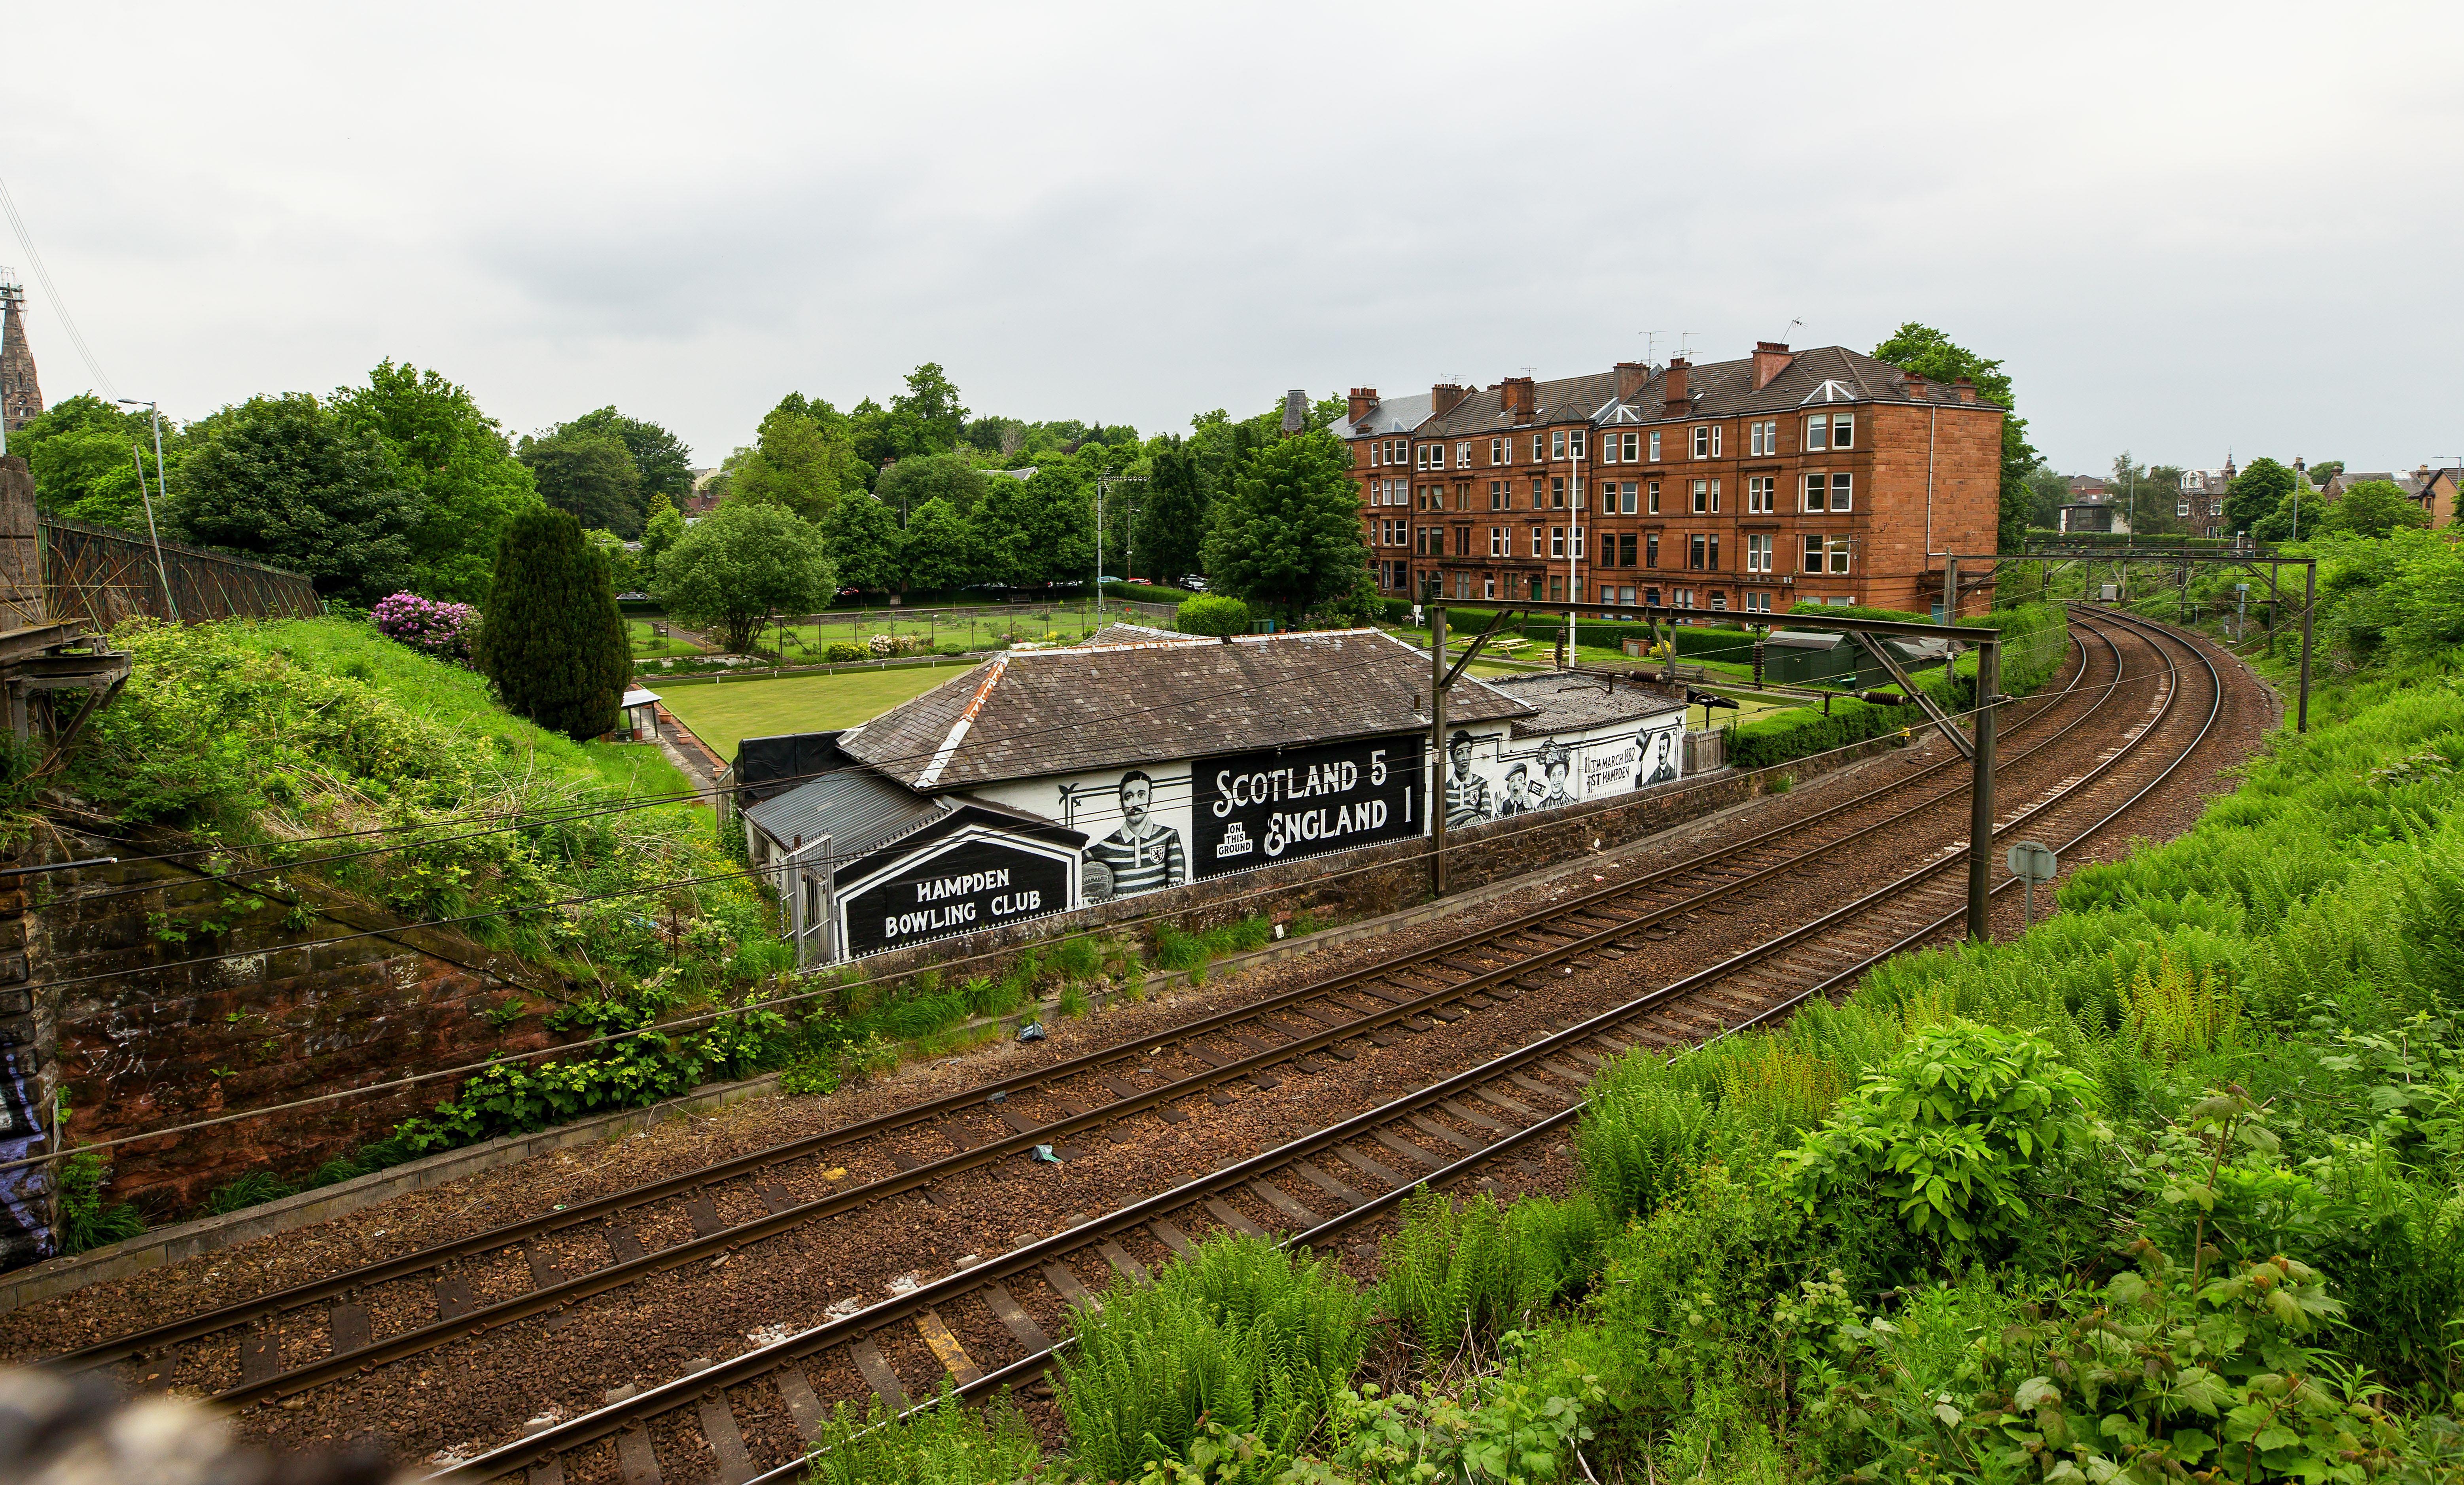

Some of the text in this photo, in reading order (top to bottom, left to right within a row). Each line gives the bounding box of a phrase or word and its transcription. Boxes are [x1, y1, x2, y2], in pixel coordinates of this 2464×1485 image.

[1602, 754, 1623, 769] MARCH
[1213, 750, 1385, 817] SCOTLAND 5
[1226, 833, 1243, 844] THIS
[1230, 824, 1241, 834] ON
[1264, 800, 1387, 856] ENGLAND
[1219, 842, 1251, 855] GROUND
[917, 868, 1009, 902] HAMPDEN
[886, 891, 1041, 938] BOWLING CLUB
